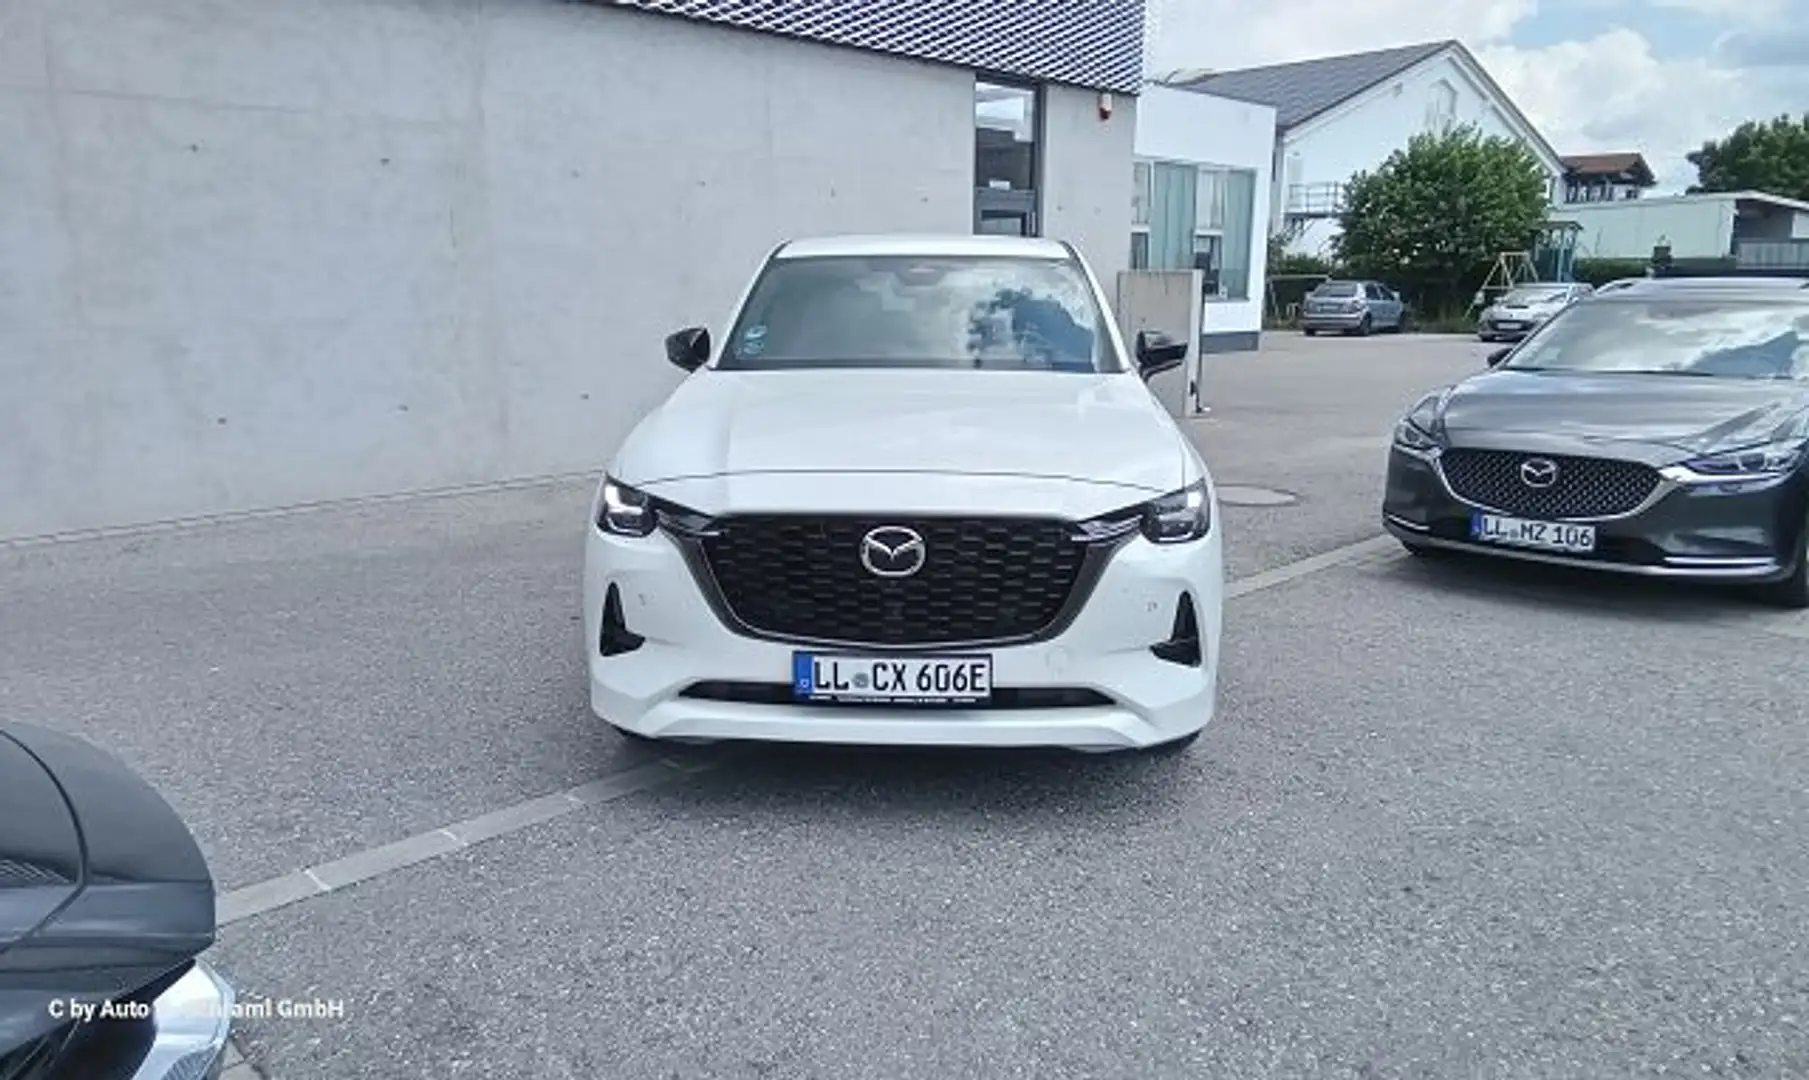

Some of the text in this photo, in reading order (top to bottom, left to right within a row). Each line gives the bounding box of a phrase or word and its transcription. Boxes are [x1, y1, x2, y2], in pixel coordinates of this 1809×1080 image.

[1483, 517, 1592, 547] LL MZ 106
[814, 661, 986, 692] LL CX 606E
